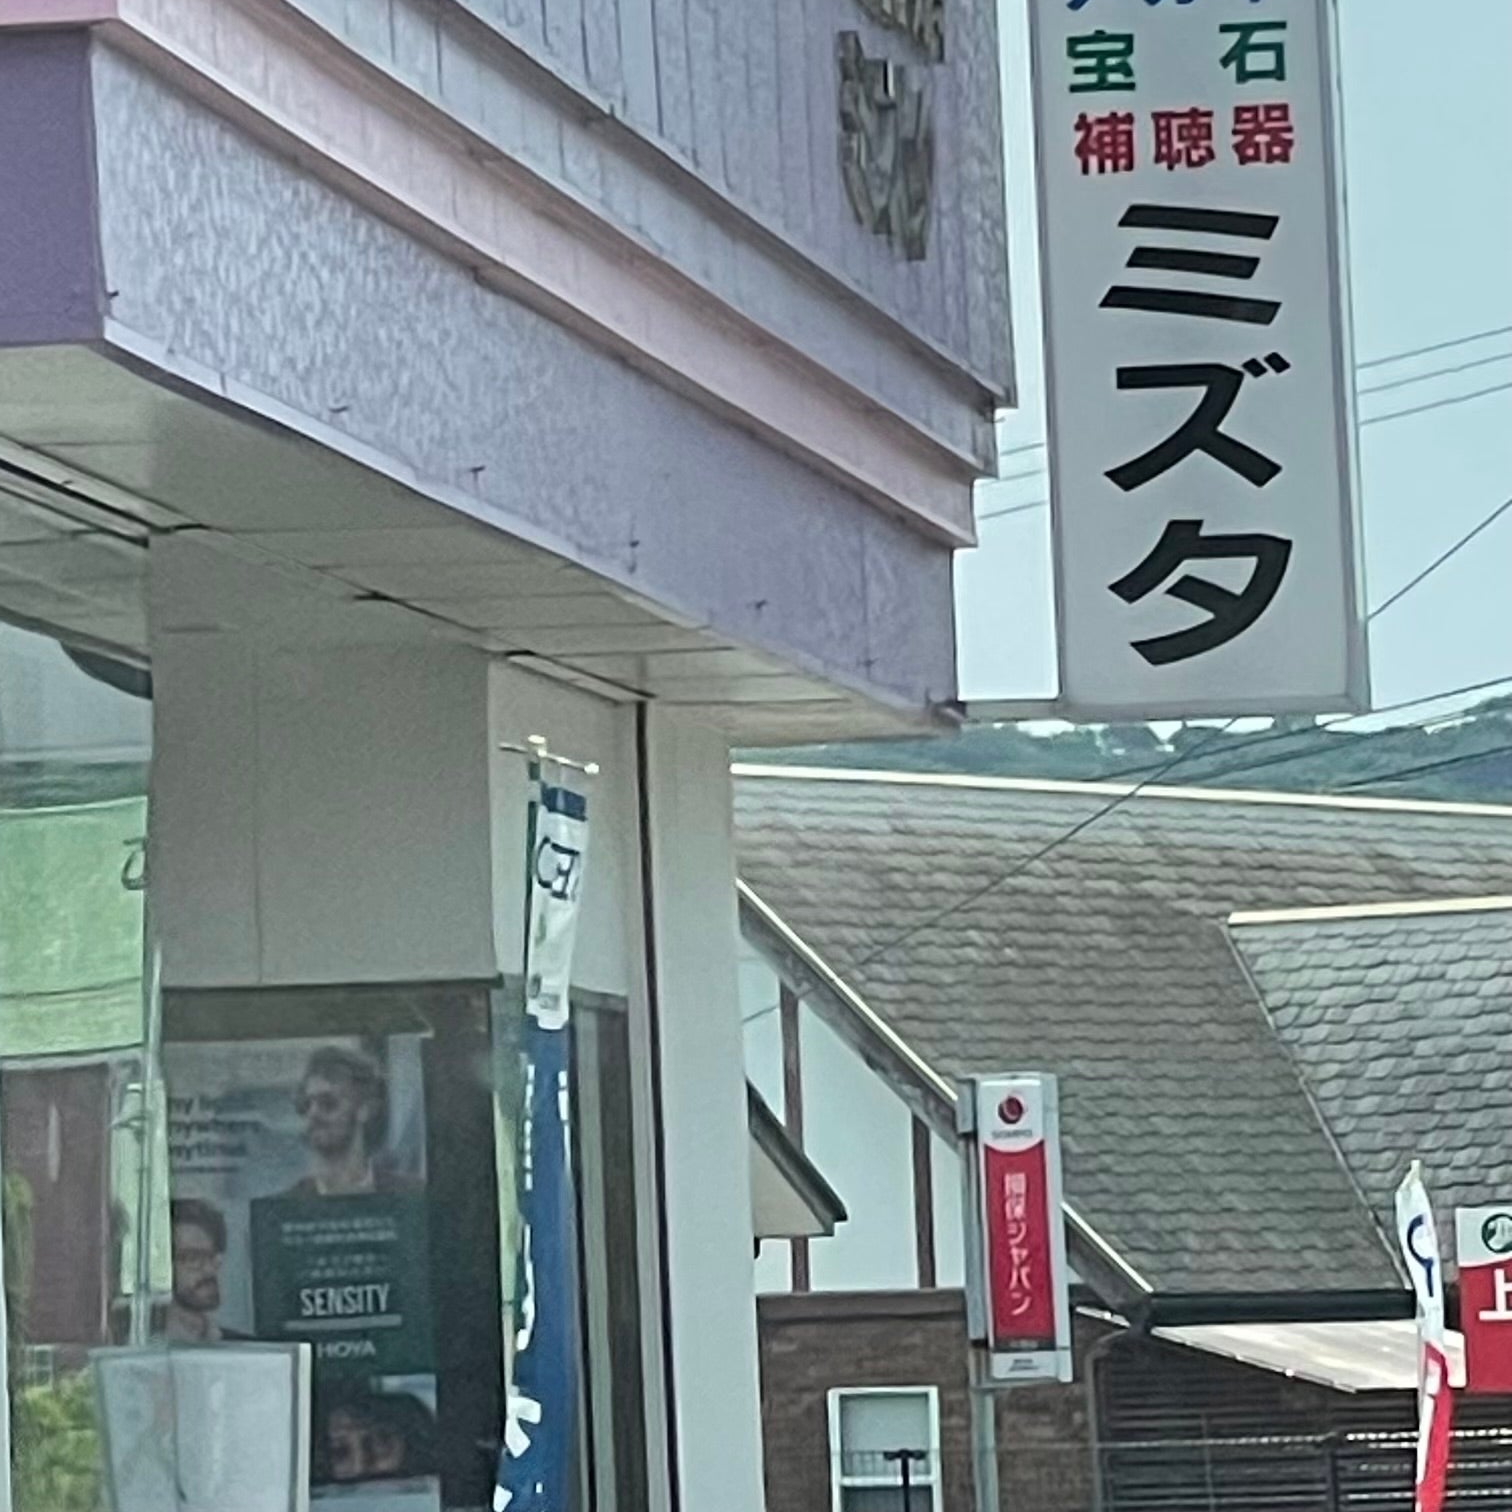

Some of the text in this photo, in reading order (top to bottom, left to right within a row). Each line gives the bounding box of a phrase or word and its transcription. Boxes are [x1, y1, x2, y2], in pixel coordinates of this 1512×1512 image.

[1066, 21, 1287, 93] 宝石
[1073, 103, 1294, 175] 補聴器
[1099, 204, 1293, 666] ミズタ
[300, 1283, 390, 1316] SENSITY
[316, 1340, 376, 1358] HOYA
